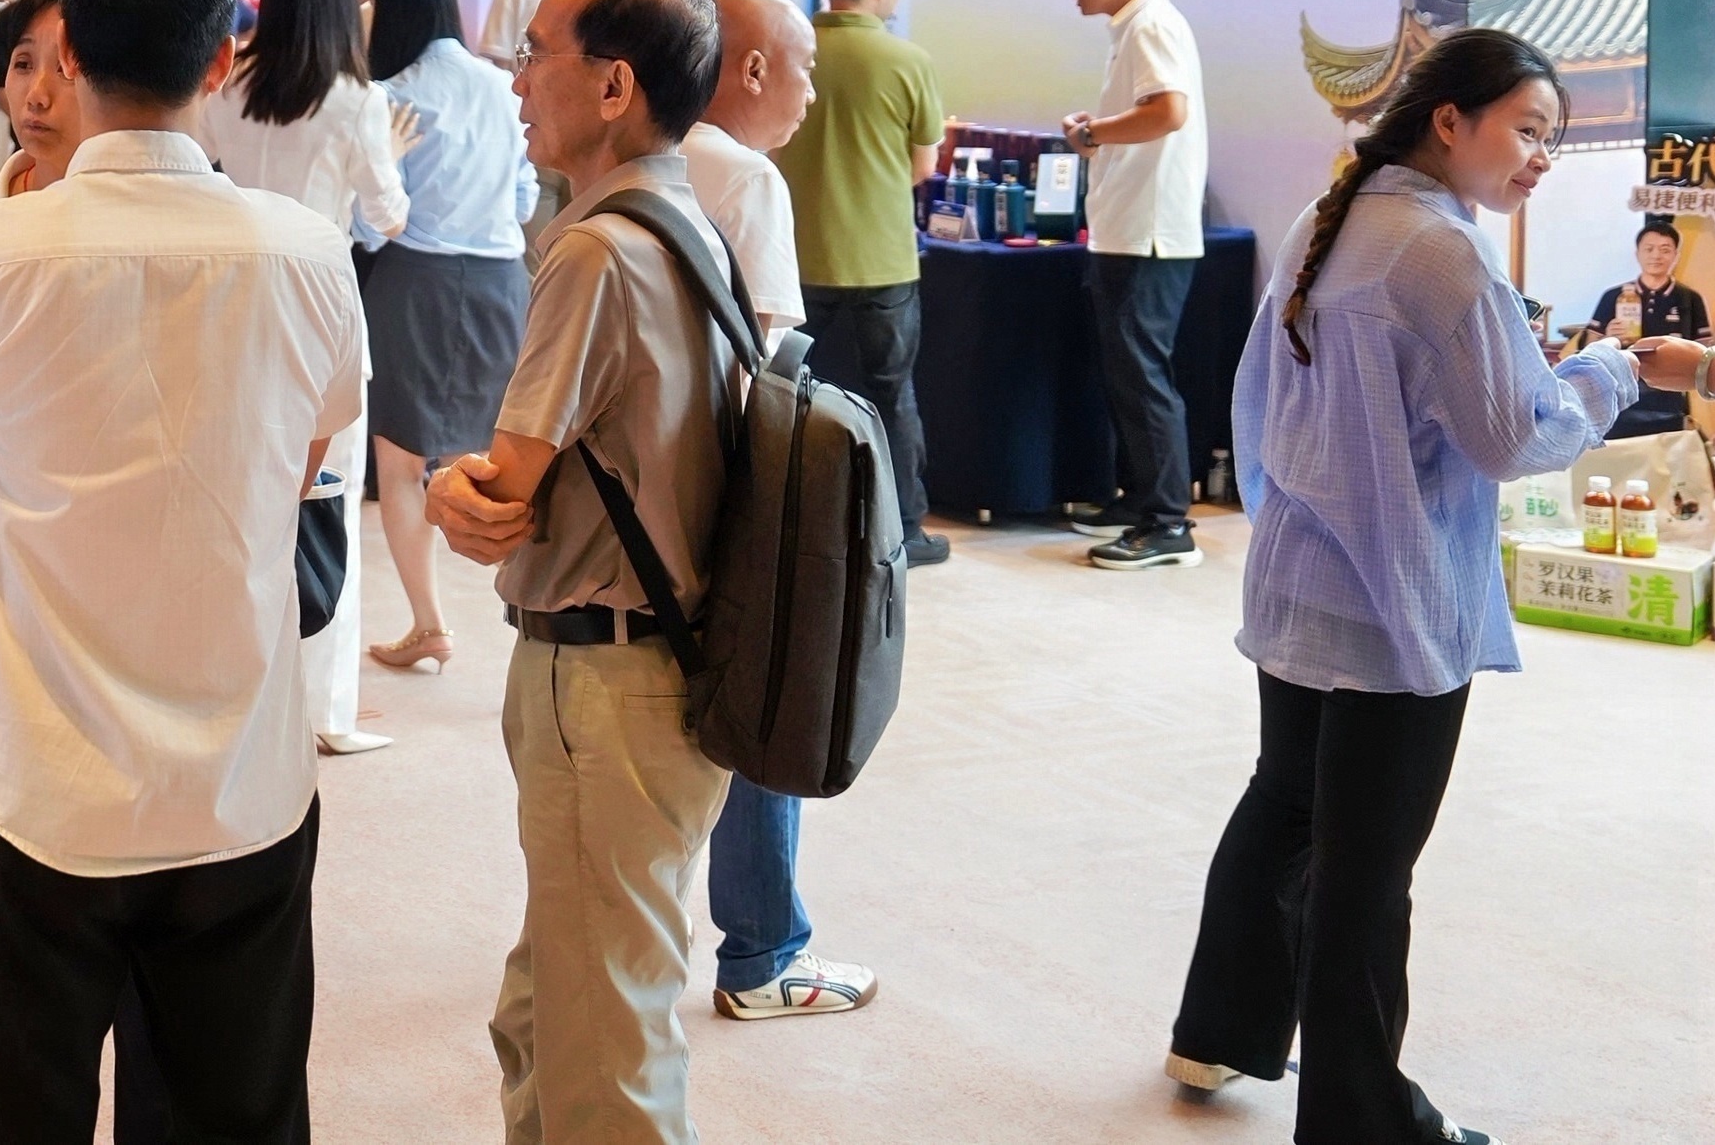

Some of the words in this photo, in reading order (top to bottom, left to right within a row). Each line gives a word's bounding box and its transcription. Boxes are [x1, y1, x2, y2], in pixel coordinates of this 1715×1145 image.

[1539, 560, 1595, 584] 罗汉果
[1539, 580, 1614, 605] 茉莉花茶
[1628, 574, 1679, 626] 清
